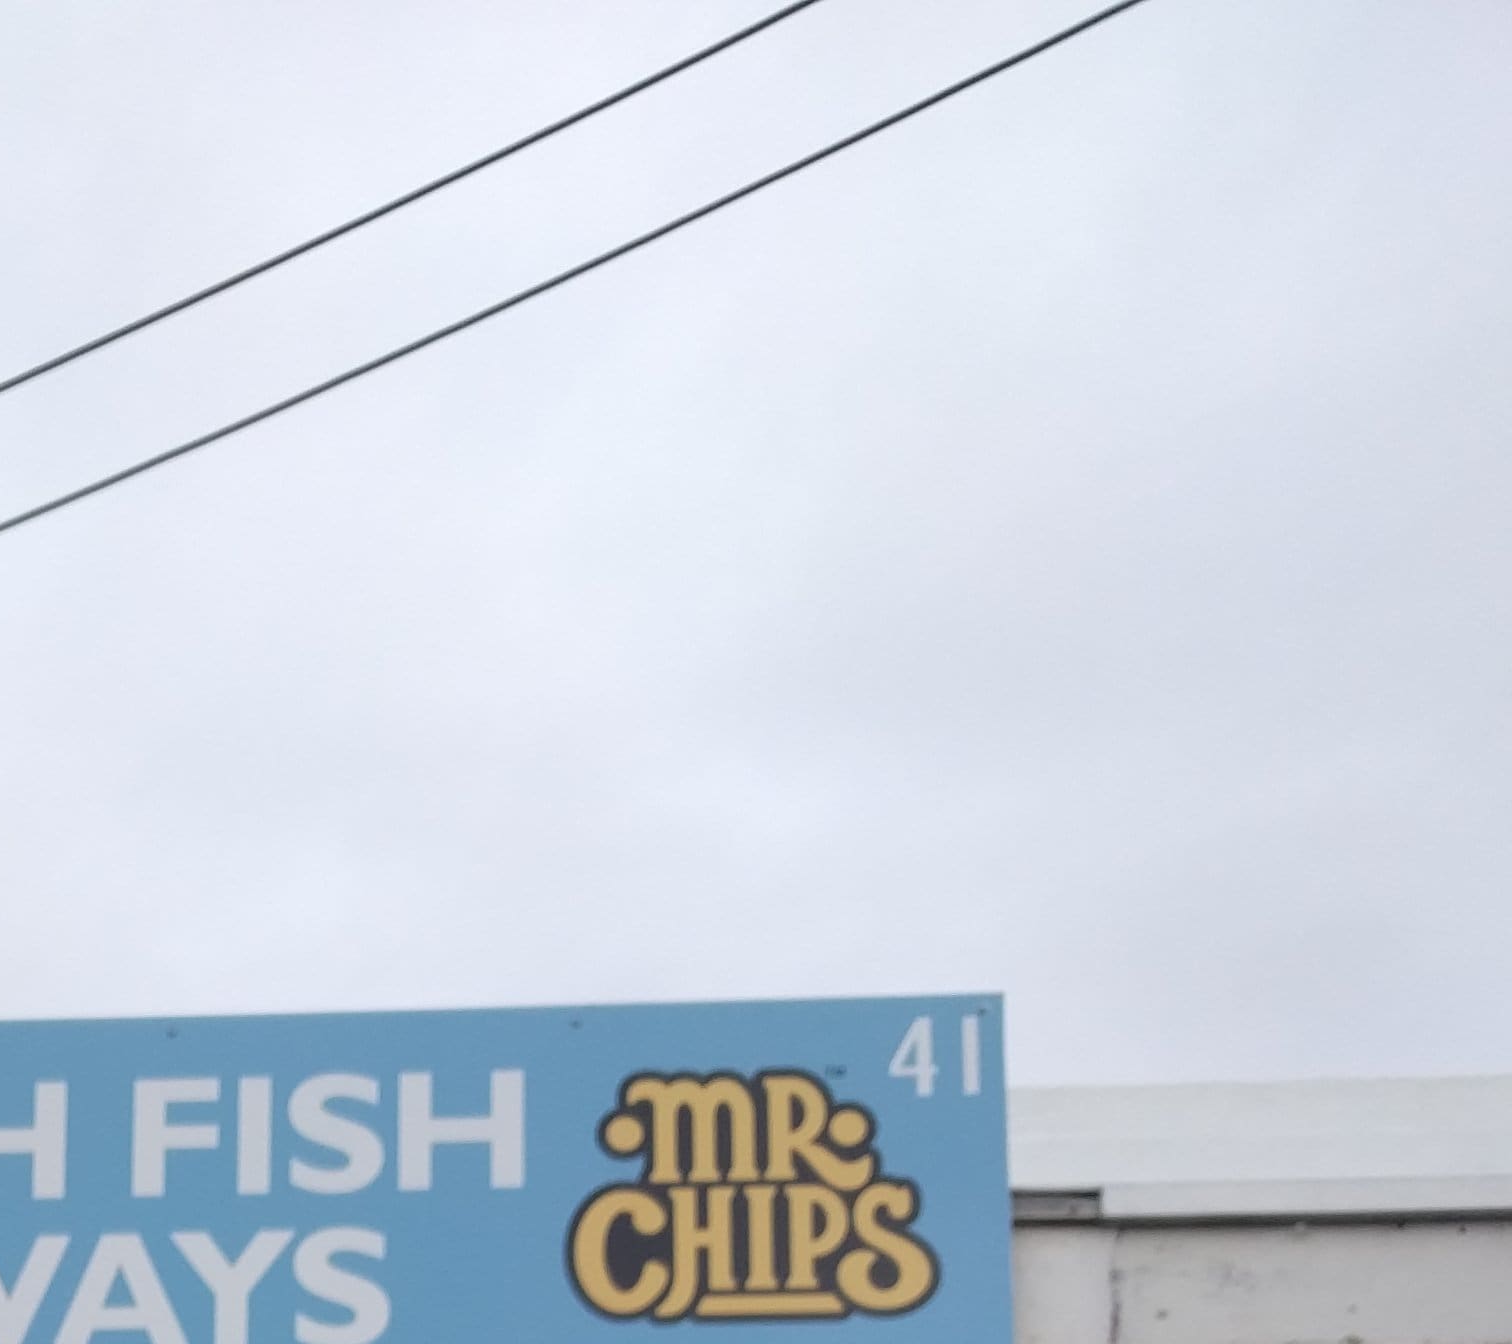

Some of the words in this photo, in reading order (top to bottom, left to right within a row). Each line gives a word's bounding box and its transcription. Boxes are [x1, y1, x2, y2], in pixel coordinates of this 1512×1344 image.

[889, 1014, 980, 1097] 41
[131, 1069, 525, 1198] FISH
[566, 1174, 940, 1324] CHIPS
